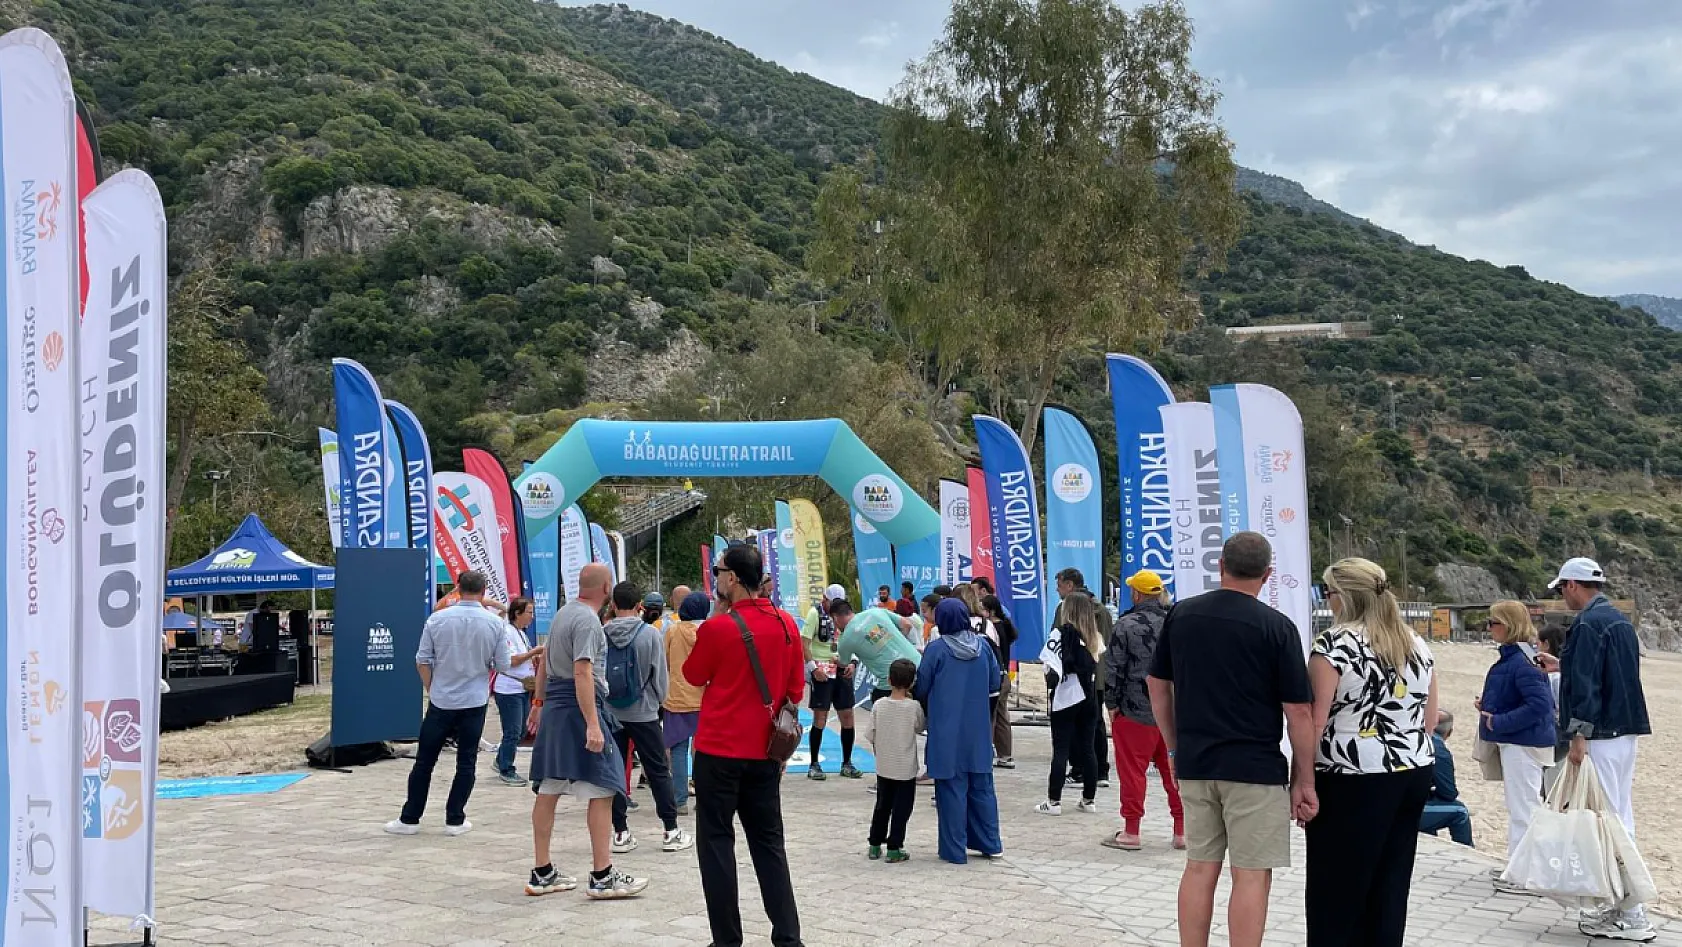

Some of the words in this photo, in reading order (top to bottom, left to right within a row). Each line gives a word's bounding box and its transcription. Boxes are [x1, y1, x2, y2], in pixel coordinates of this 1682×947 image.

[901, 565, 919, 579] SKY
[174, 574, 219, 586] BELEDİYESİ
[221, 574, 252, 584] KÜLTÜR
[254, 573, 279, 584] İŞLERİ
